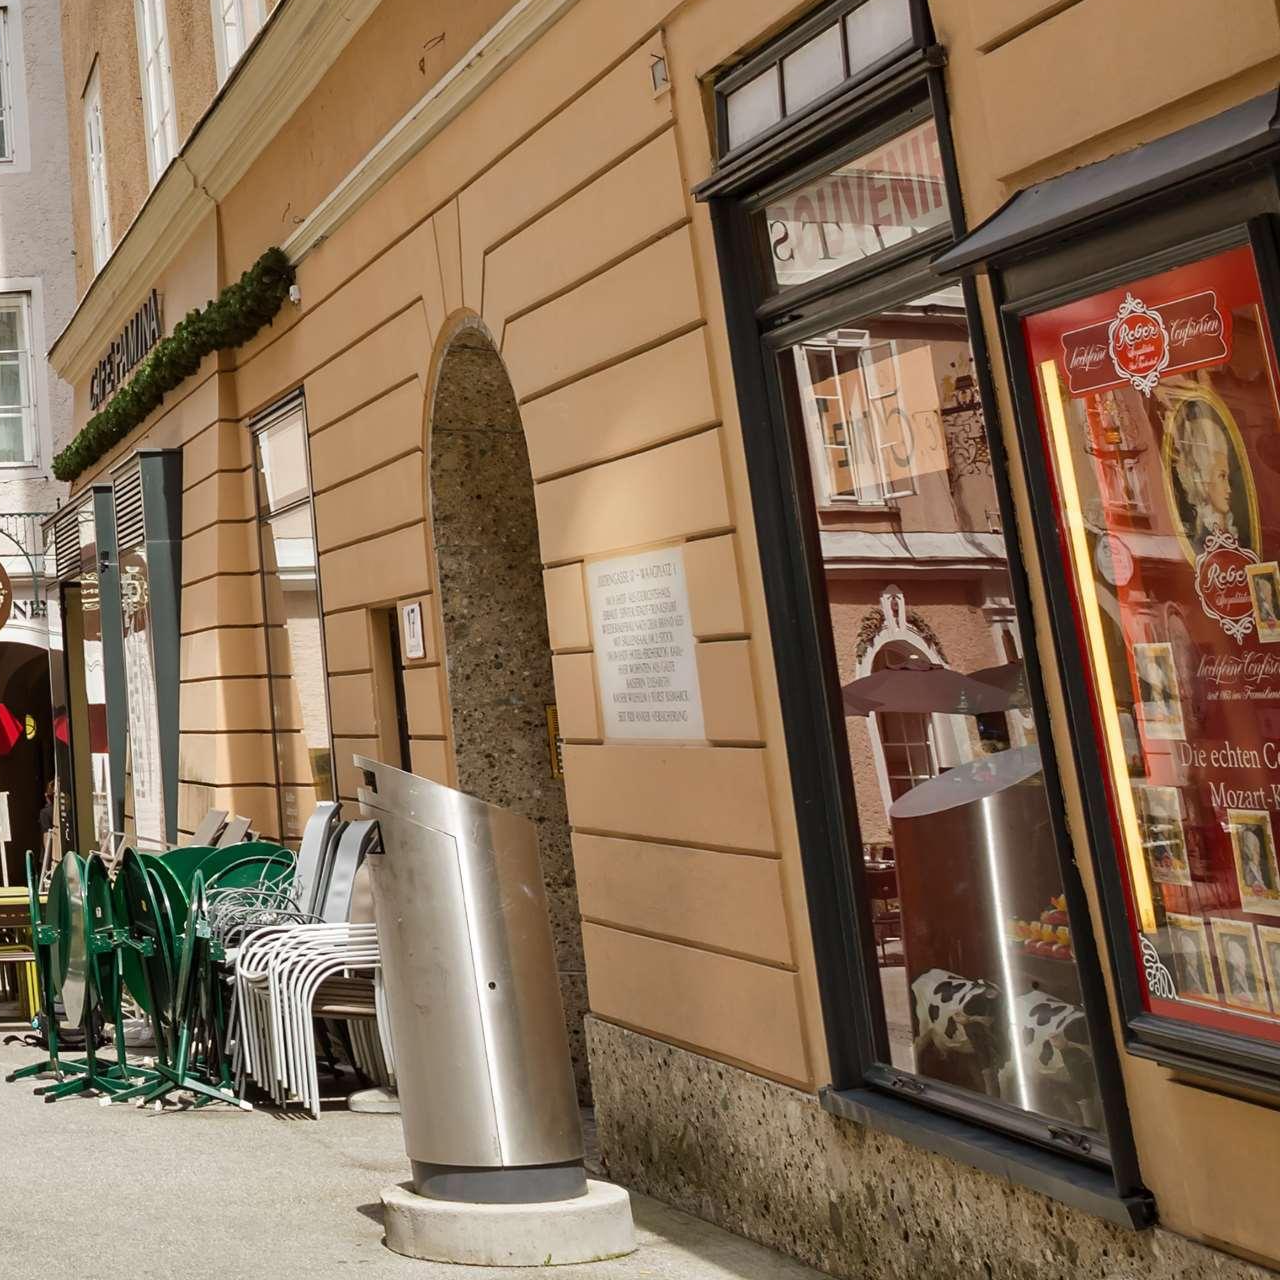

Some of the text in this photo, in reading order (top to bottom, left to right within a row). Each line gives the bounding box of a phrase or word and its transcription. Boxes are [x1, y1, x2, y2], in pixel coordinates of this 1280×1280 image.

[116, 288, 162, 386] PAMINA
[1115, 322, 1158, 350] Reber
[1203, 563, 1246, 589] Rebe
[1180, 741, 1208, 768] Die
[1210, 740, 1261, 769] echten
